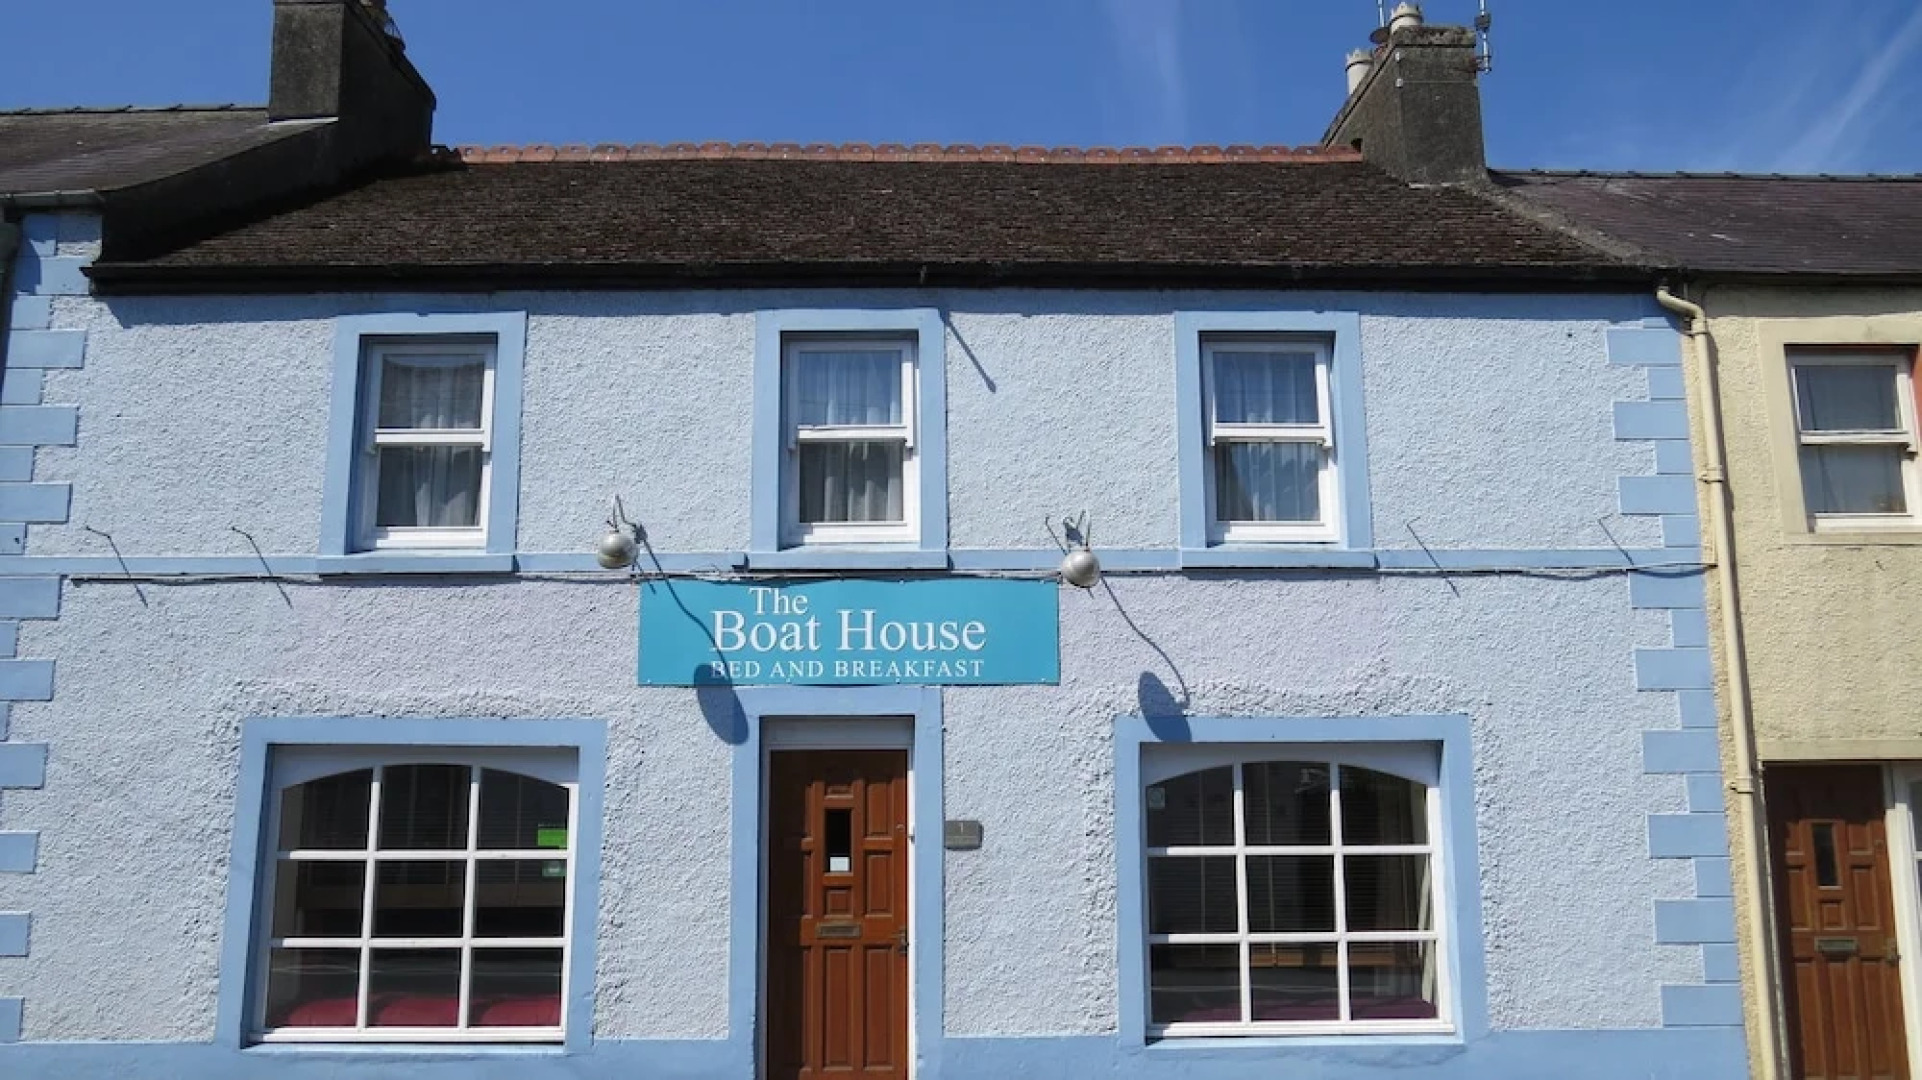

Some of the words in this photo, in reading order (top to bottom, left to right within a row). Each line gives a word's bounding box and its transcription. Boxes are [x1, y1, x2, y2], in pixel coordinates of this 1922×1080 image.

[748, 587, 808, 615] The
[711, 609, 821, 652] Boat
[836, 609, 987, 652] House
[711, 660, 761, 678] BED
[769, 660, 824, 678] AND
[834, 660, 985, 678] BREAKFAST
